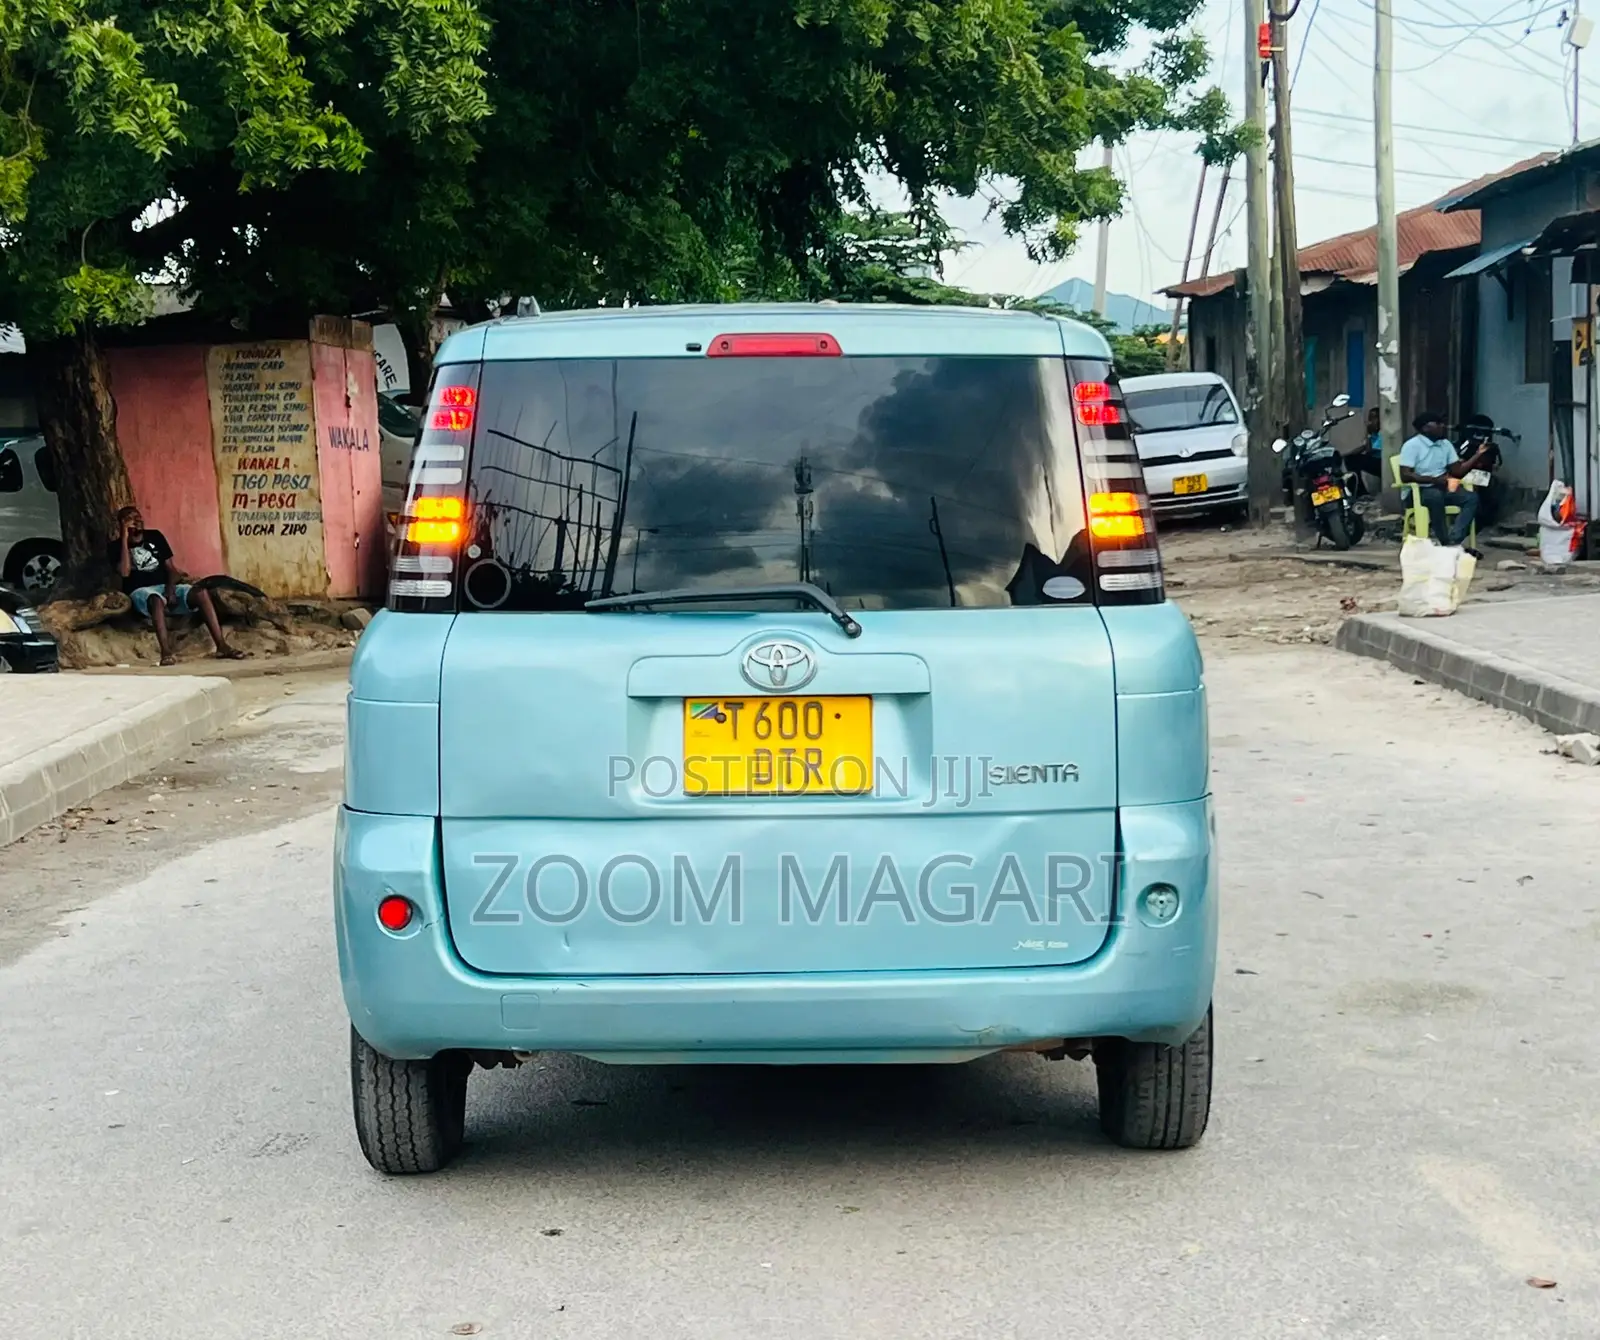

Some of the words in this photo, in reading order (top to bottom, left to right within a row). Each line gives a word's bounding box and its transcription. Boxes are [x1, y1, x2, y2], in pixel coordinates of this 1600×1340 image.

[261, 361, 285, 370] CARD
[223, 373, 255, 382] FLASH
[279, 381, 303, 390] SIMU
[283, 392, 297, 401] CD
[223, 404, 246, 413] TUNA
[248, 403, 277, 412] FLASH
[247, 413, 292, 422] COMPUTER
[328, 426, 370, 452] WAKALA
[244, 445, 276, 453] FLASH
[237, 457, 291, 471] WAKALA
[231, 474, 268, 490] TIGO
[238, 524, 276, 537] VOCHA
[280, 523, 308, 537] ZIPO
[724, 702, 745, 741] T
[754, 701, 824, 741] 600
[754, 748, 824, 786] DTR
[989, 763, 1079, 786] SIENTA
